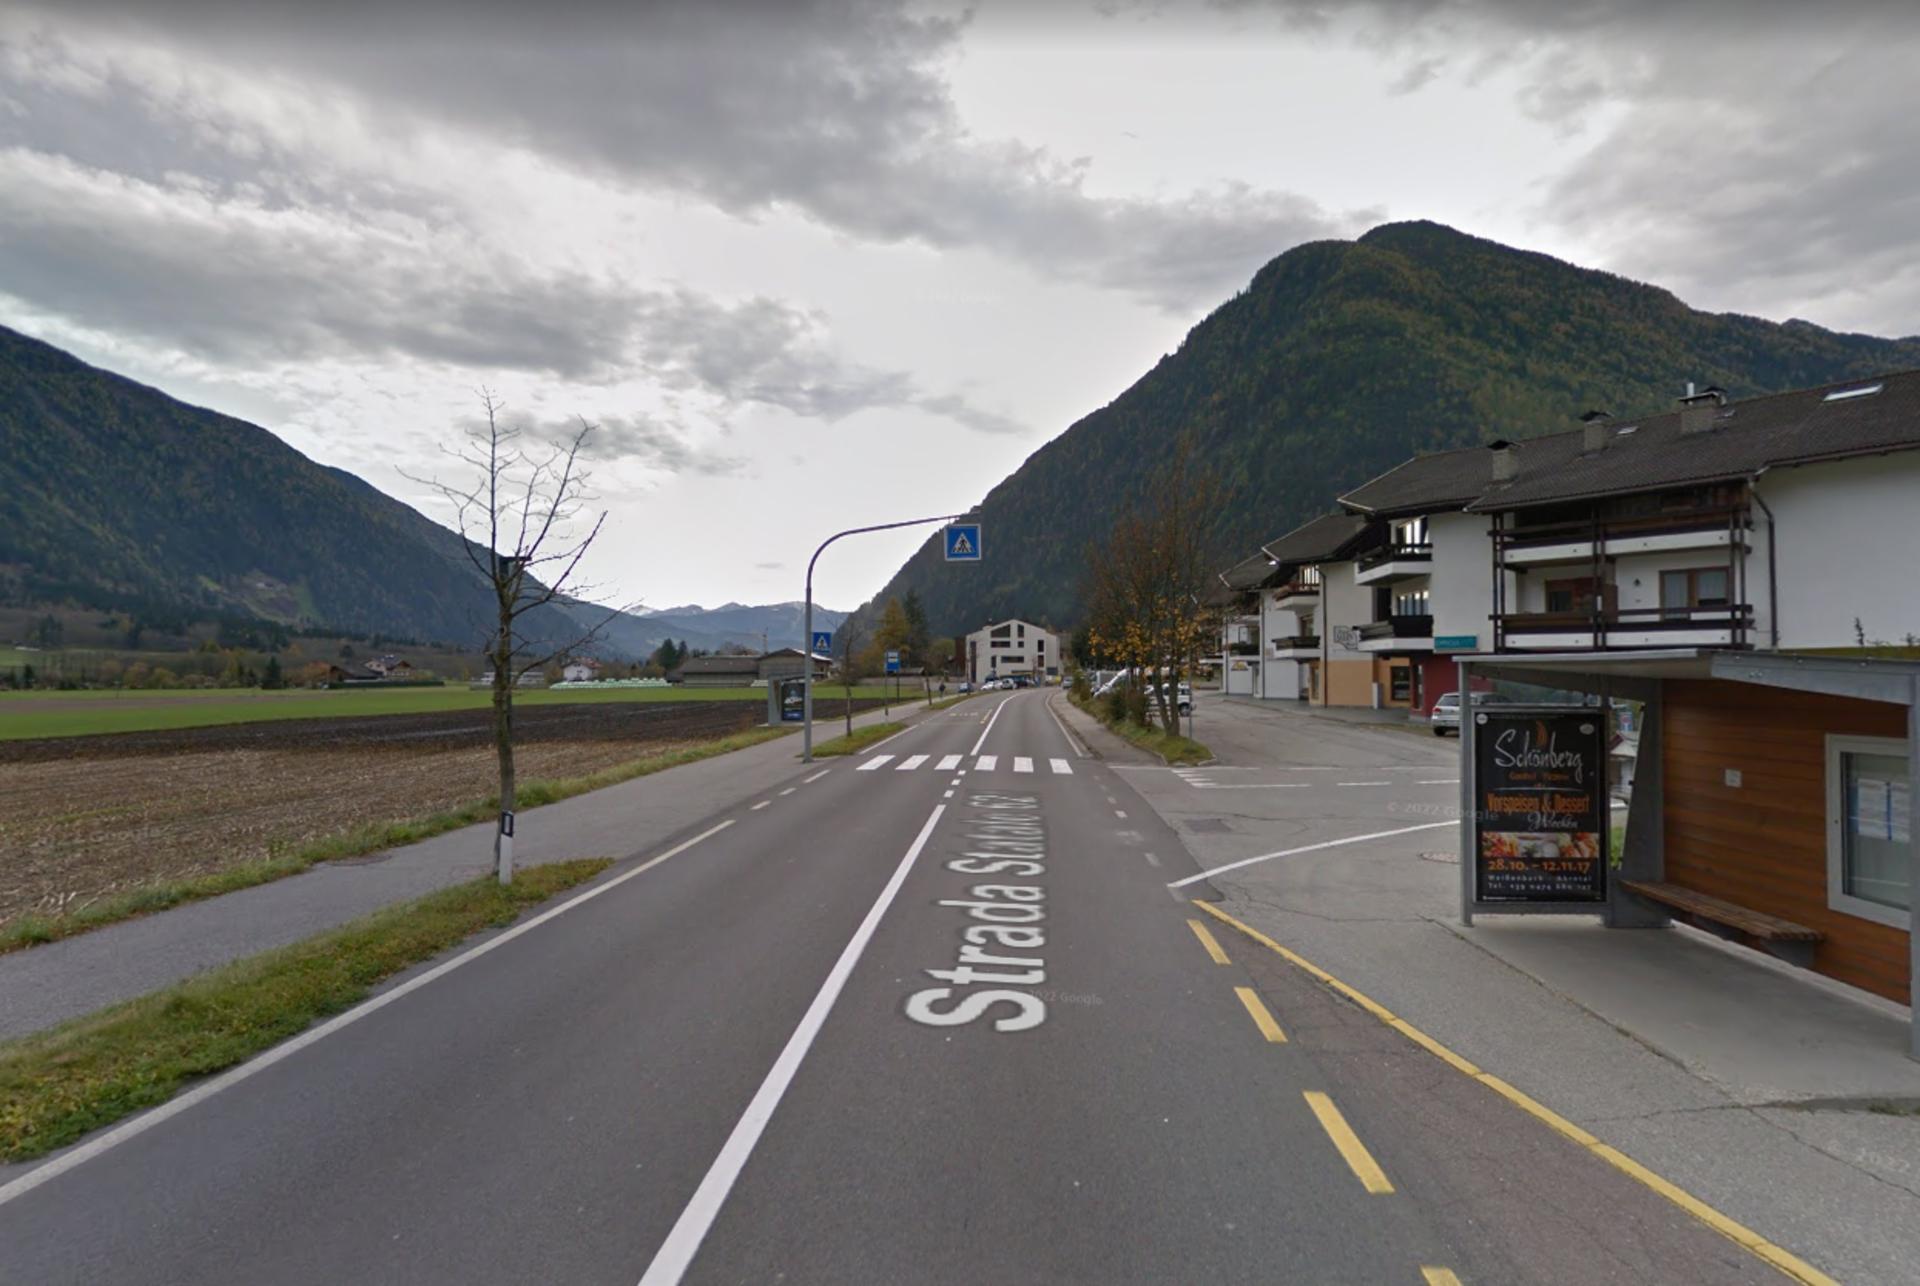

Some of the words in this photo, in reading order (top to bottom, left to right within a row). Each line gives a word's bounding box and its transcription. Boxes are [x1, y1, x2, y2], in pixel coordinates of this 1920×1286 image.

[1494, 728, 1584, 785] Schönberg
[1488, 859, 1529, 872] 28.10.
[1542, 861, 1591, 874] 12.11.17
